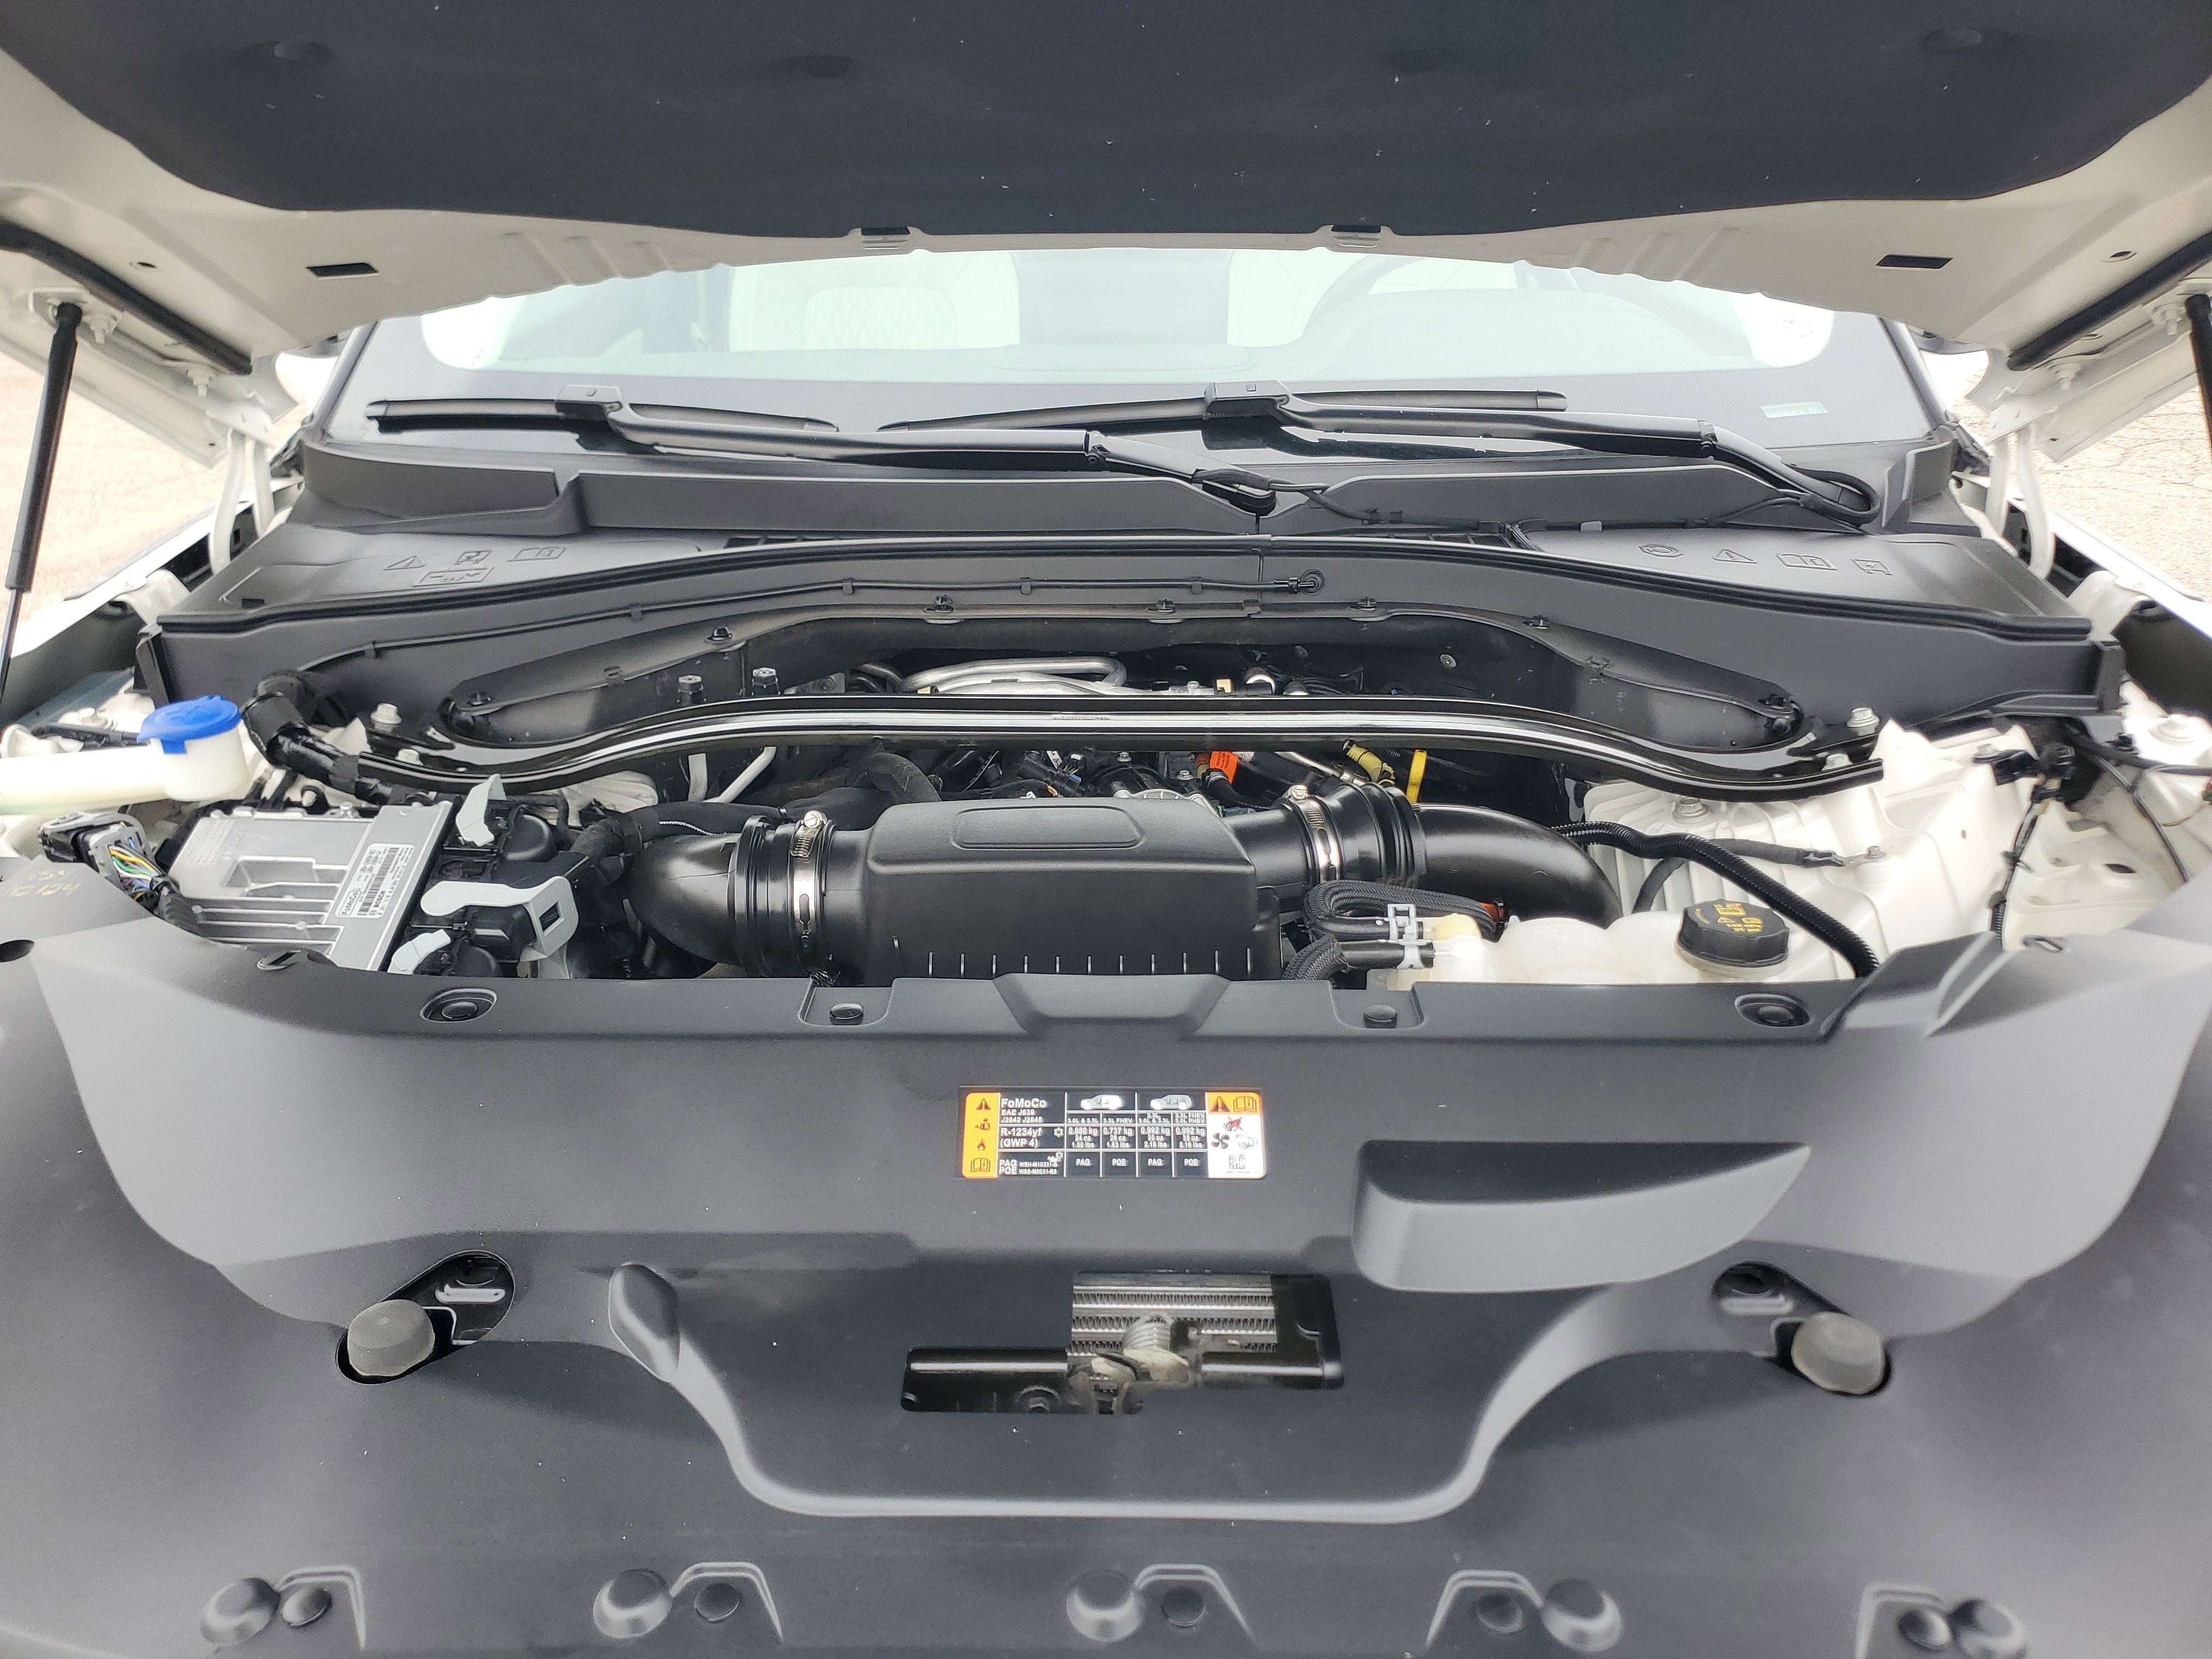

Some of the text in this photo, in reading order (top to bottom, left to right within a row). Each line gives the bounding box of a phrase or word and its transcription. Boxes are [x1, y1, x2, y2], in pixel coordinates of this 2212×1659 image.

[1001, 1098, 1047, 1108] FoMoCo
[1001, 1127, 1042, 1138] R-1234yf
[1088, 1126, 1098, 1137] kg
[1124, 1126, 1132, 1137] kg
[1161, 1126, 1170, 1136] kg
[1196, 1127, 1205, 1137] kg
[1000, 1138, 1038, 1148] (GWP 4)
